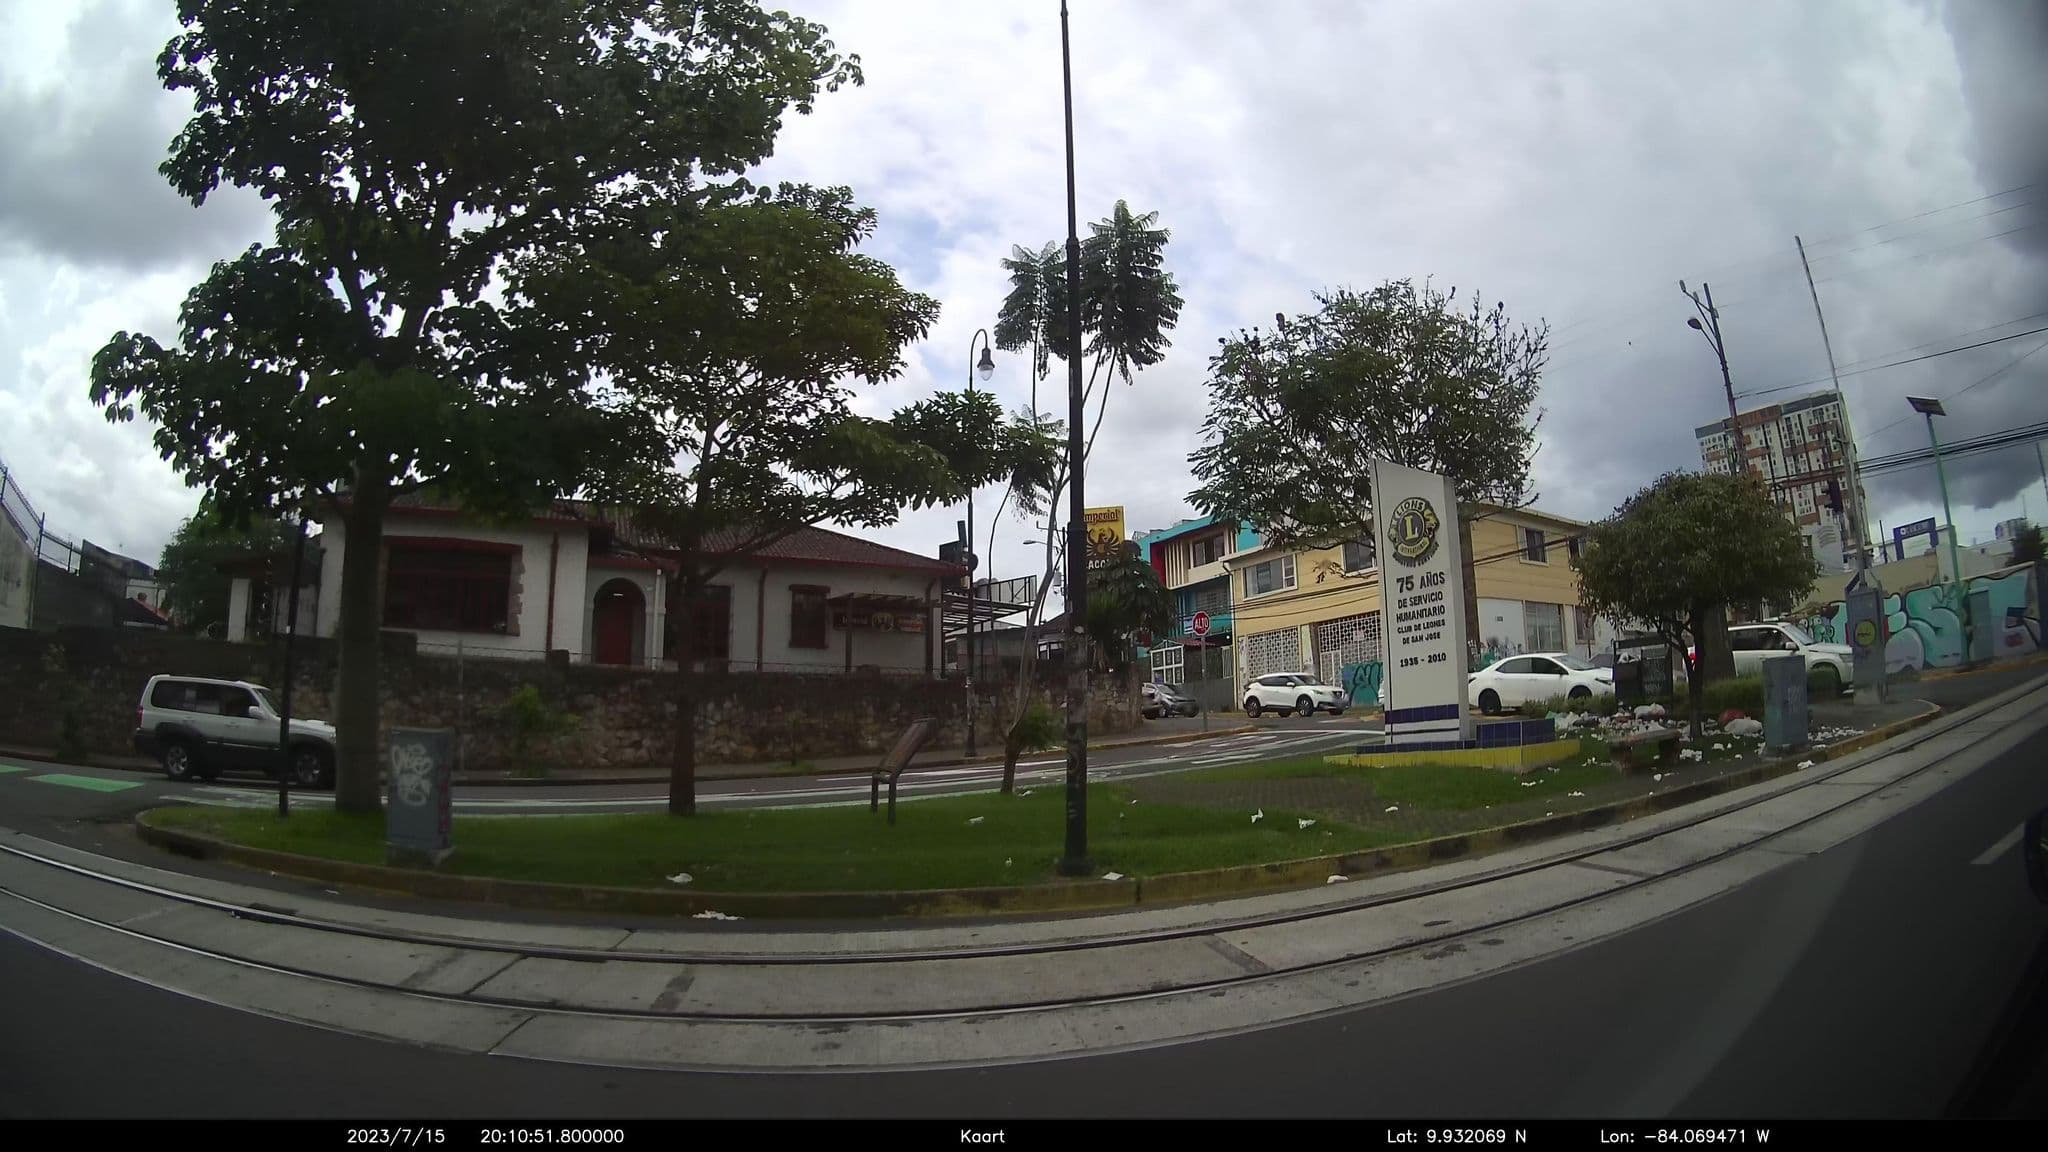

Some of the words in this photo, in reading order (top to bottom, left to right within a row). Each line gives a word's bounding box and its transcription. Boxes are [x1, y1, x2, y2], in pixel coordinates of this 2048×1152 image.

[1395, 500, 1424, 516] LIONS
[1084, 509, 1119, 525] mperial
[1404, 515, 1419, 540] L
[1396, 575, 1414, 593] 75
[1420, 571, 1445, 589] AÑOS
[1398, 598, 1407, 609] DE
[1409, 591, 1443, 607] SERVICIO
[1396, 605, 1445, 624] HUMANITARIO
[1195, 617, 1208, 629] ALTO
[1397, 625, 1412, 634] CLUB
[1414, 623, 1421, 632] DE
[1423, 619, 1445, 630] LEONES
[1402, 637, 1410, 645] DE
[1411, 635, 1424, 643] SAN
[1425, 632, 1441, 641] JOSE
[1427, 652, 1447, 663] 2010
